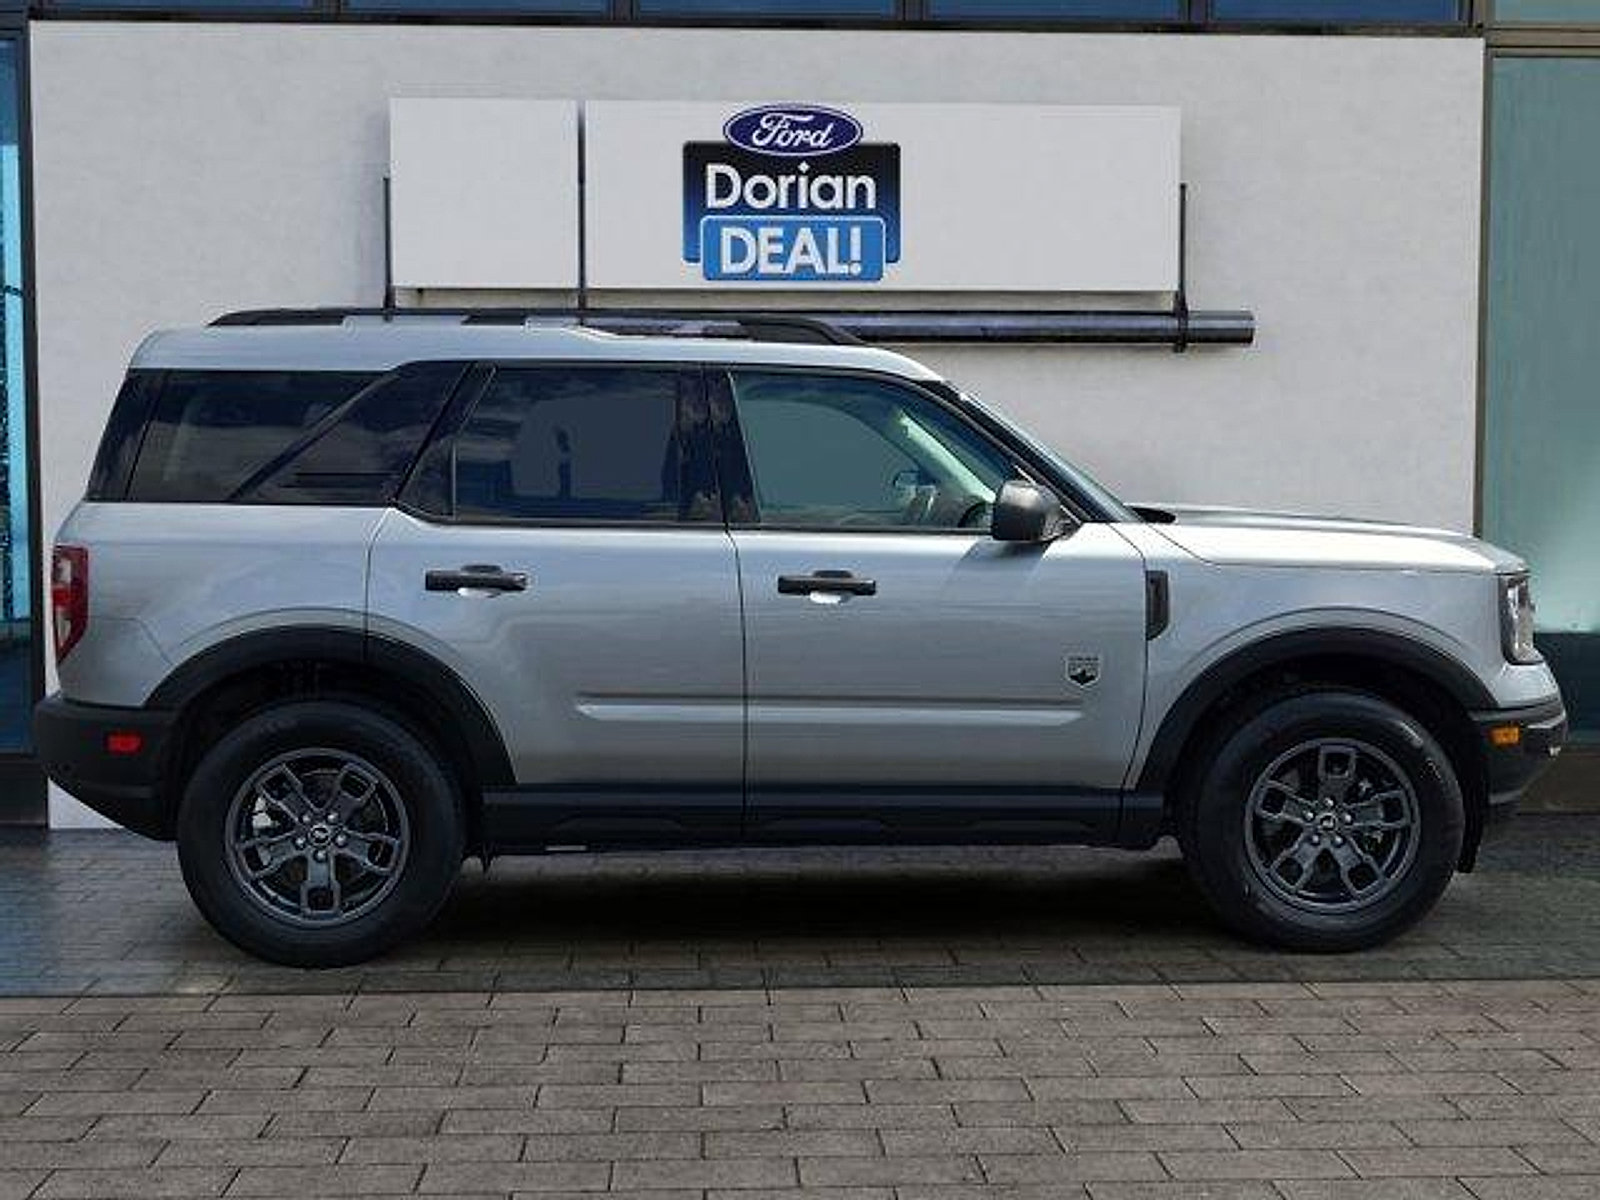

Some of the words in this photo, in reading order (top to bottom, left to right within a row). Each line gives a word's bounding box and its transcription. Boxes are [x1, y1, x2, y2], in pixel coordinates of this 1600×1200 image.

[752, 112, 834, 147] Ford
[706, 161, 876, 209] Dorian
[720, 227, 862, 276] DEAL!
